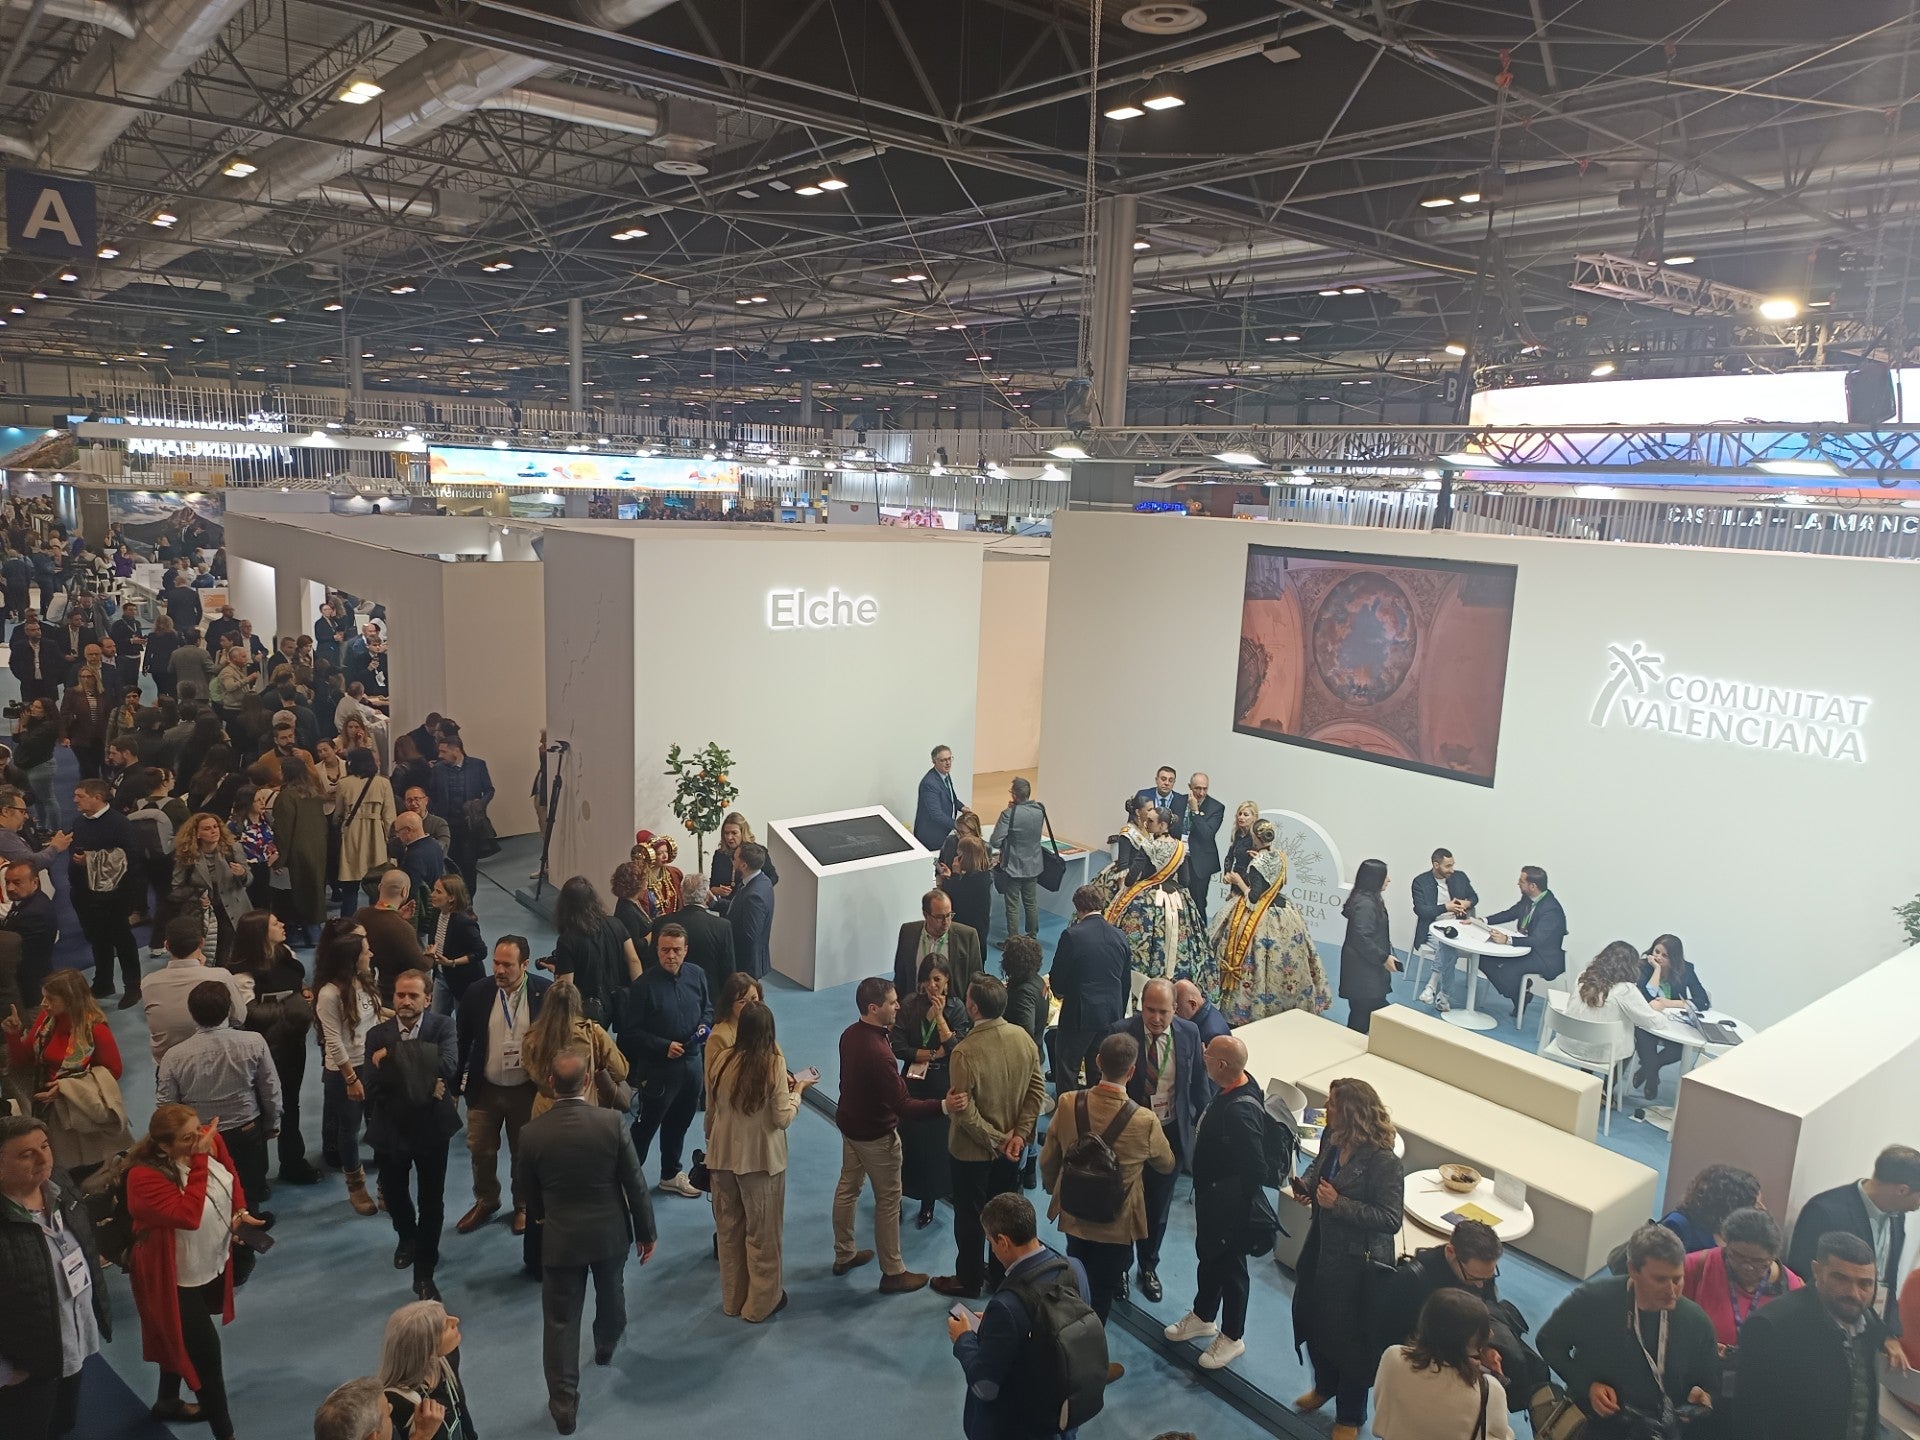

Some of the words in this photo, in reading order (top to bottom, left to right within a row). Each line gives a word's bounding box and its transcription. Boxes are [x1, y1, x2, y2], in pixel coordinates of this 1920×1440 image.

[21, 187, 83, 247] A
[1446, 377, 1458, 402] B
[421, 487, 493, 499] Extremadura
[770, 589, 879, 628] Elche
[1664, 675, 1869, 726] COMUNITAT
[1620, 698, 1864, 763] VALENCIANA
[1291, 887, 1341, 907] CIELO
